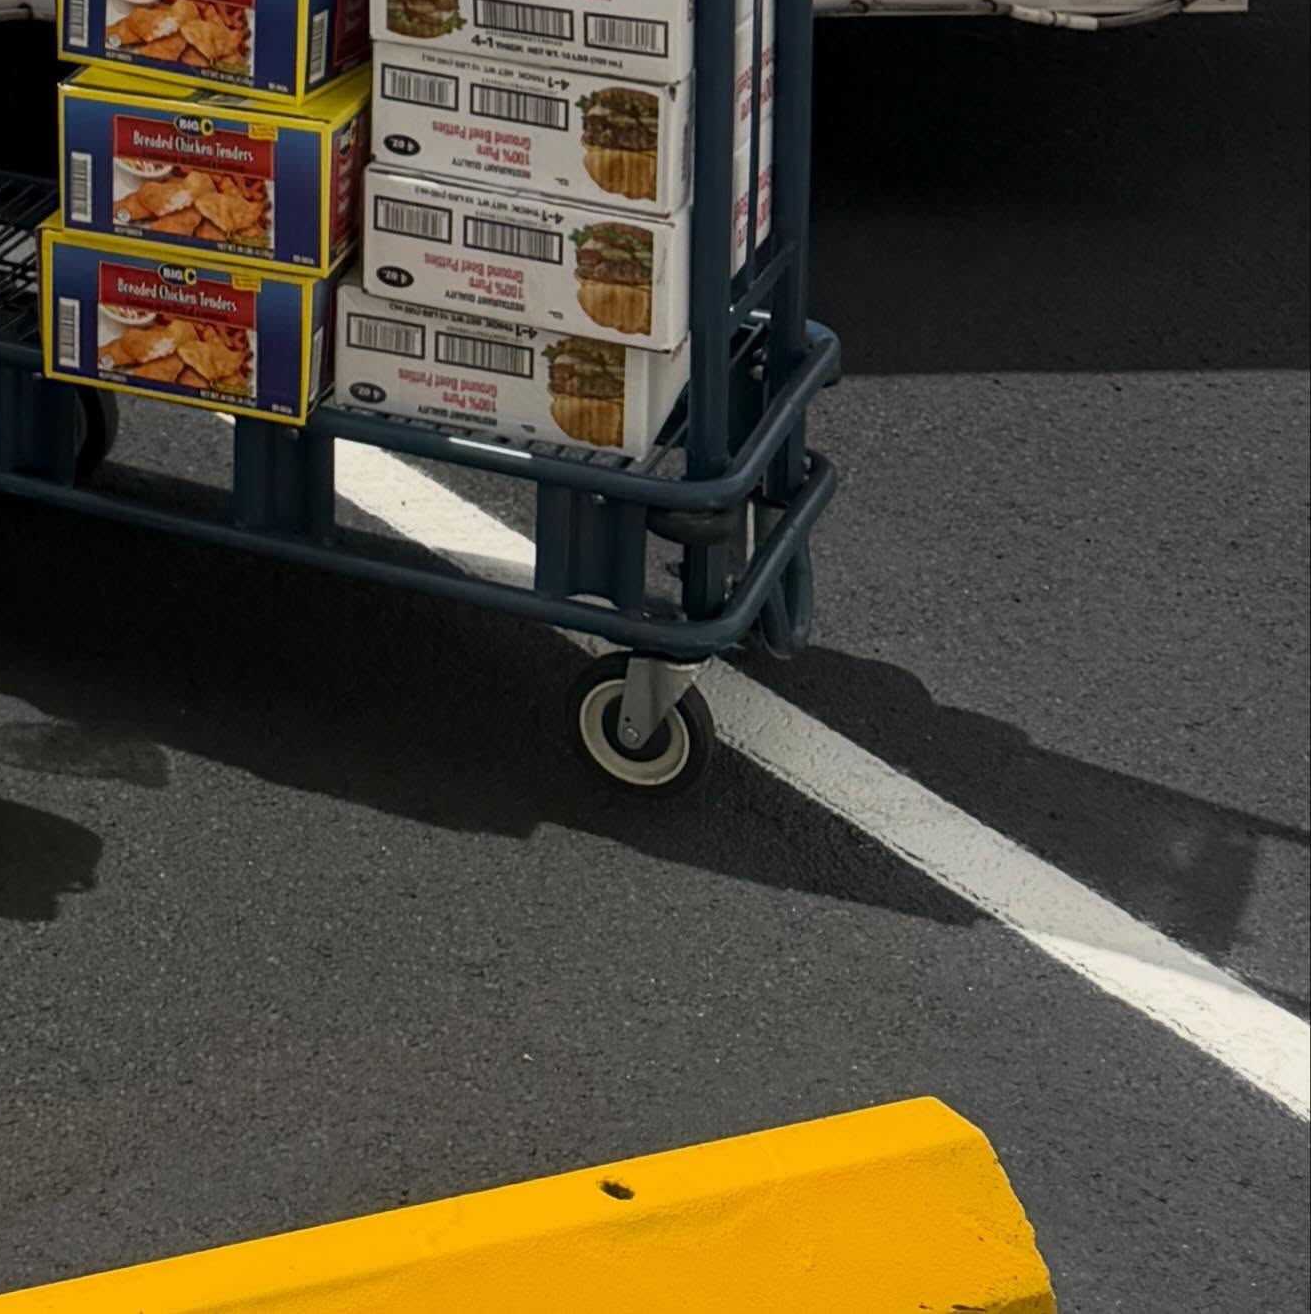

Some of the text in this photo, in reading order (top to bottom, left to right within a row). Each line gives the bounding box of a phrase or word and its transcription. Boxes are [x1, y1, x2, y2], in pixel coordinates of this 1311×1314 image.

[471, 34, 493, 48] 4-1
[527, 46, 544, 54] NET
[178, 119, 199, 131] BIG
[471, 126, 492, 142] Beef
[133, 130, 254, 162] Breaded Chicken Tenders
[494, 132, 531, 149] Ground
[477, 144, 530, 165] 100% Pure
[163, 266, 183, 279] BIG
[461, 259, 483, 276] Beef
[487, 264, 524, 283] Ground
[117, 277, 238, 312] Breaded Chicken Tenders
[469, 276, 523, 299] 100% Pure
[434, 375, 458, 389] Beef
[460, 380, 498, 398] Ground
[442, 391, 497, 413] 100% Pure
